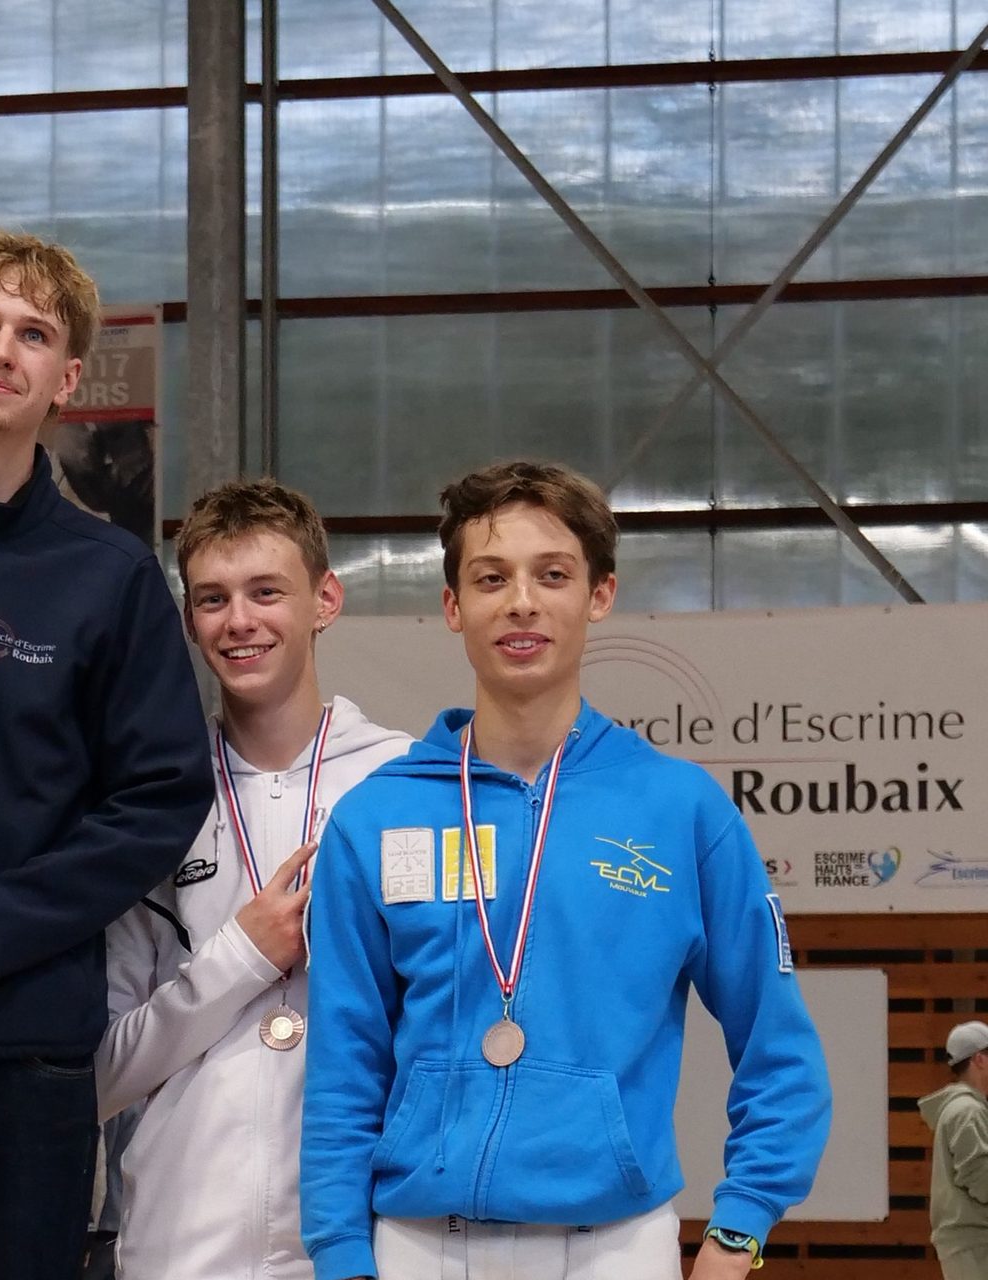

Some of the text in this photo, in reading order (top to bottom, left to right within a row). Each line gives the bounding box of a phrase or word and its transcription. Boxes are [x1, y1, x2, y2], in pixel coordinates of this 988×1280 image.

[14, 639, 56, 652] d'Escrime
[12, 649, 54, 664] Roubaix
[732, 701, 965, 745] d'Escrime
[732, 762, 965, 815] Roubaix
[814, 852, 866, 865] ESCRIME
[814, 865, 852, 876] HAUTS
[814, 876, 869, 887] FRANCE
